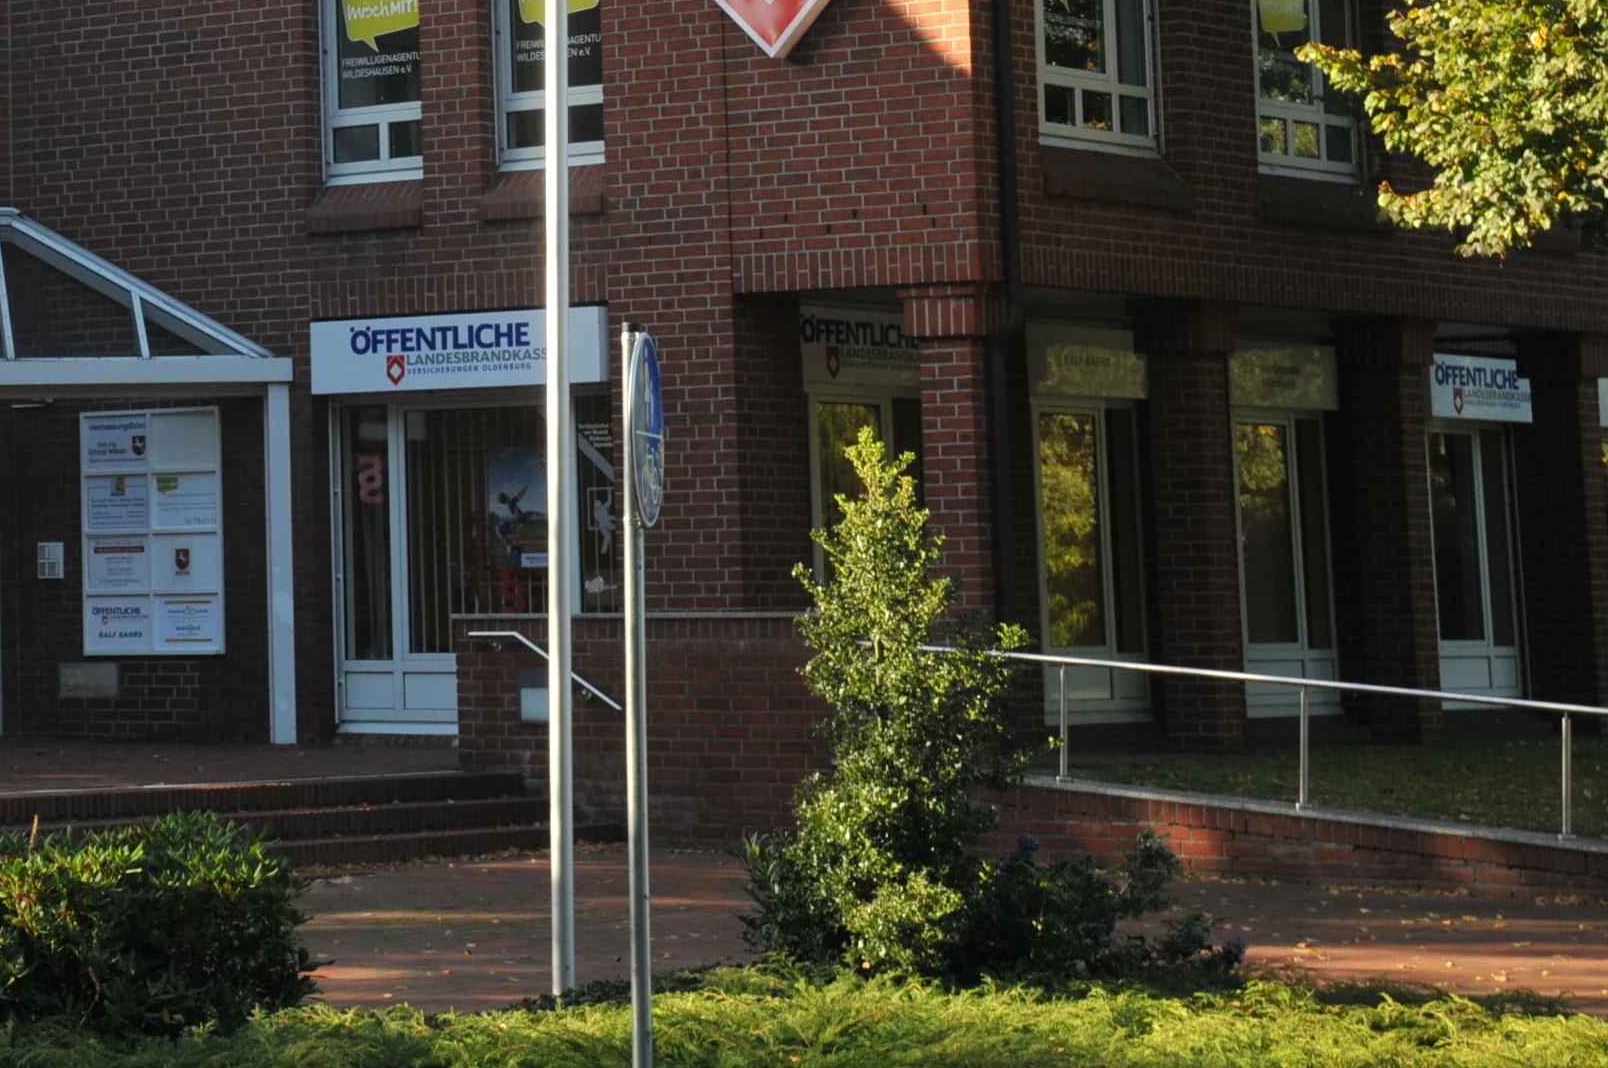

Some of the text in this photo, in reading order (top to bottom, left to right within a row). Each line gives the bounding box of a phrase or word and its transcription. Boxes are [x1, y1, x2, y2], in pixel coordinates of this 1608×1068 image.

[342, 51, 421, 67] FREIWILLIGENAGENTU
[342, 65, 399, 79] WILDESHAUSEN
[349, 322, 531, 355] ÖFFENTLICHE
[407, 348, 548, 366] LANDESBRANDKASS
[407, 362, 532, 375] VERSICHERUNGEN OLDENBURG
[1434, 360, 1520, 390] ÖFFENTLICHE
[91, 605, 141, 615] ÖFFENTLICHE
